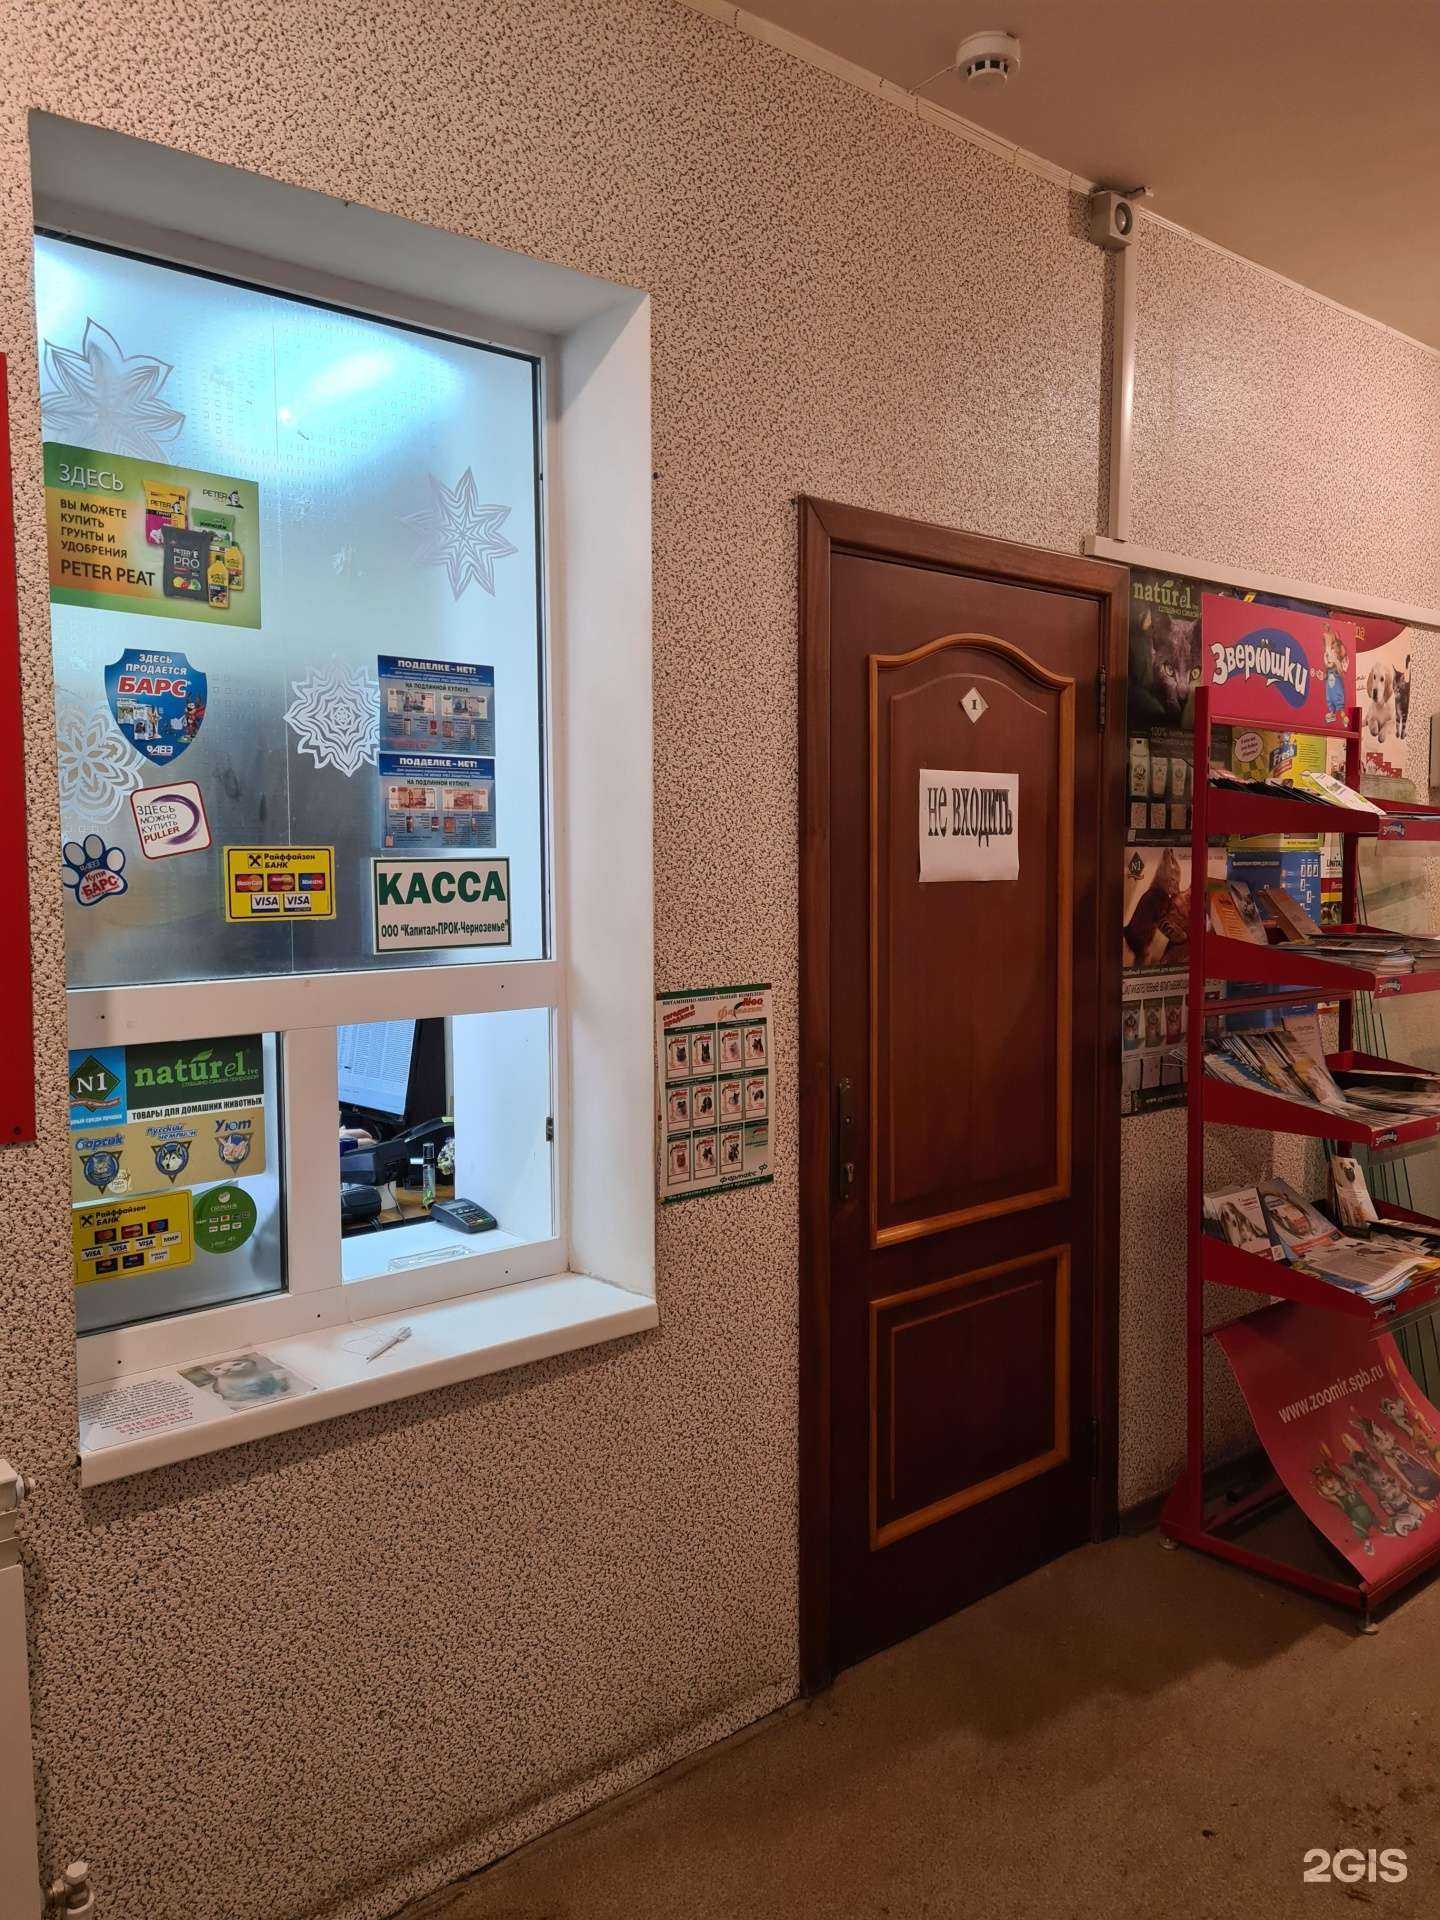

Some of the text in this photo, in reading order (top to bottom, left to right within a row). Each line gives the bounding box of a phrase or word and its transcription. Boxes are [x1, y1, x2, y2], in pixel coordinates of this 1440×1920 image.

[59, 463, 124, 491] ЗДЕСЬ
[203, 488, 227, 500] PETER
[60, 498, 127, 519] ВЫ МОЖЕТЕ
[61, 512, 105, 528] КУПИТЬ
[61, 526, 116, 544] ГРУНТЫ И
[61, 540, 127, 559] УДОБРЕНИЯ
[173, 556, 200, 568] PRO
[61, 560, 155, 587] PETER PEAT
[139, 654, 172, 664] ЗДЕСЬ
[398, 660, 449, 672] ПОДДЕЛКЕ
[126, 663, 187, 675] ПРОДАЕТСЯ
[118, 676, 188, 697] БАРС
[400, 758, 451, 767] ПОДДЕЛКЕ
[137, 806, 175, 815] ЗДЕСЬ
[141, 814, 177, 824] МОЖНО
[142, 821, 177, 833] КУПИТЬ
[144, 826, 180, 844] PULLER
[82, 875, 118, 897] БАРС
[378, 871, 506, 905] КАССА
[254, 896, 310, 906] VISA VISA
[381, 924, 398, 937] ООО
[77, 1072, 107, 1093] N1
[132, 1098, 262, 1120] ТОВАРЫ ДЛЯ ДОМАШНИХ ЖИВОТНЫХ
[1278, 1365, 1384, 1424] www.zoomir.spb.ru
